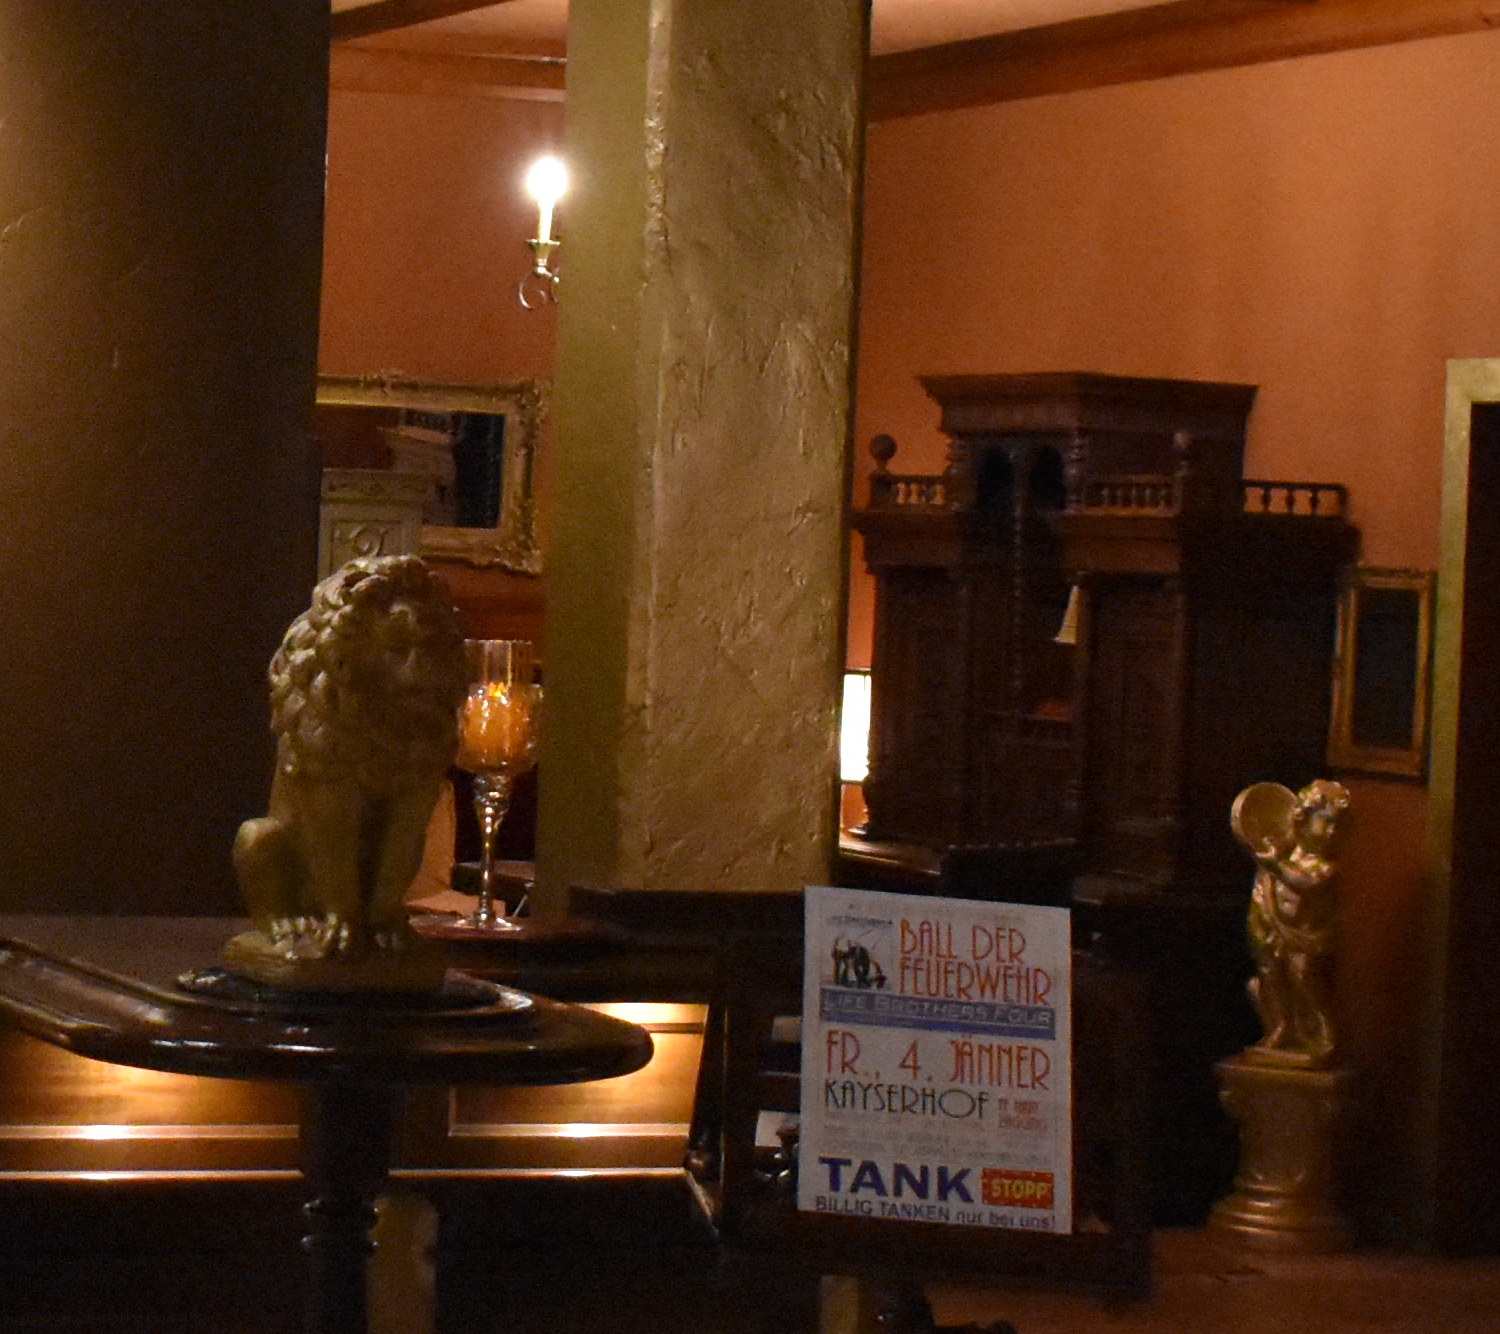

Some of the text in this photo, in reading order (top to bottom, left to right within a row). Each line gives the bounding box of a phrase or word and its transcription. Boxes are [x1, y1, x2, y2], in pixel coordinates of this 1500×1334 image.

[900, 919, 1026, 965] BALL DER
[900, 958, 1051, 1006] FEUERWEHR
[874, 996, 988, 1020] BROTHERS
[948, 1033, 1050, 1091] JÄNNER
[825, 1079, 990, 1119] KAYSERHOF
[818, 1156, 1050, 1204] TANK STOPP
[815, 1195, 873, 1217] BILLIG
[880, 1201, 950, 1222] TANKEN
[956, 1210, 983, 1223] nur
